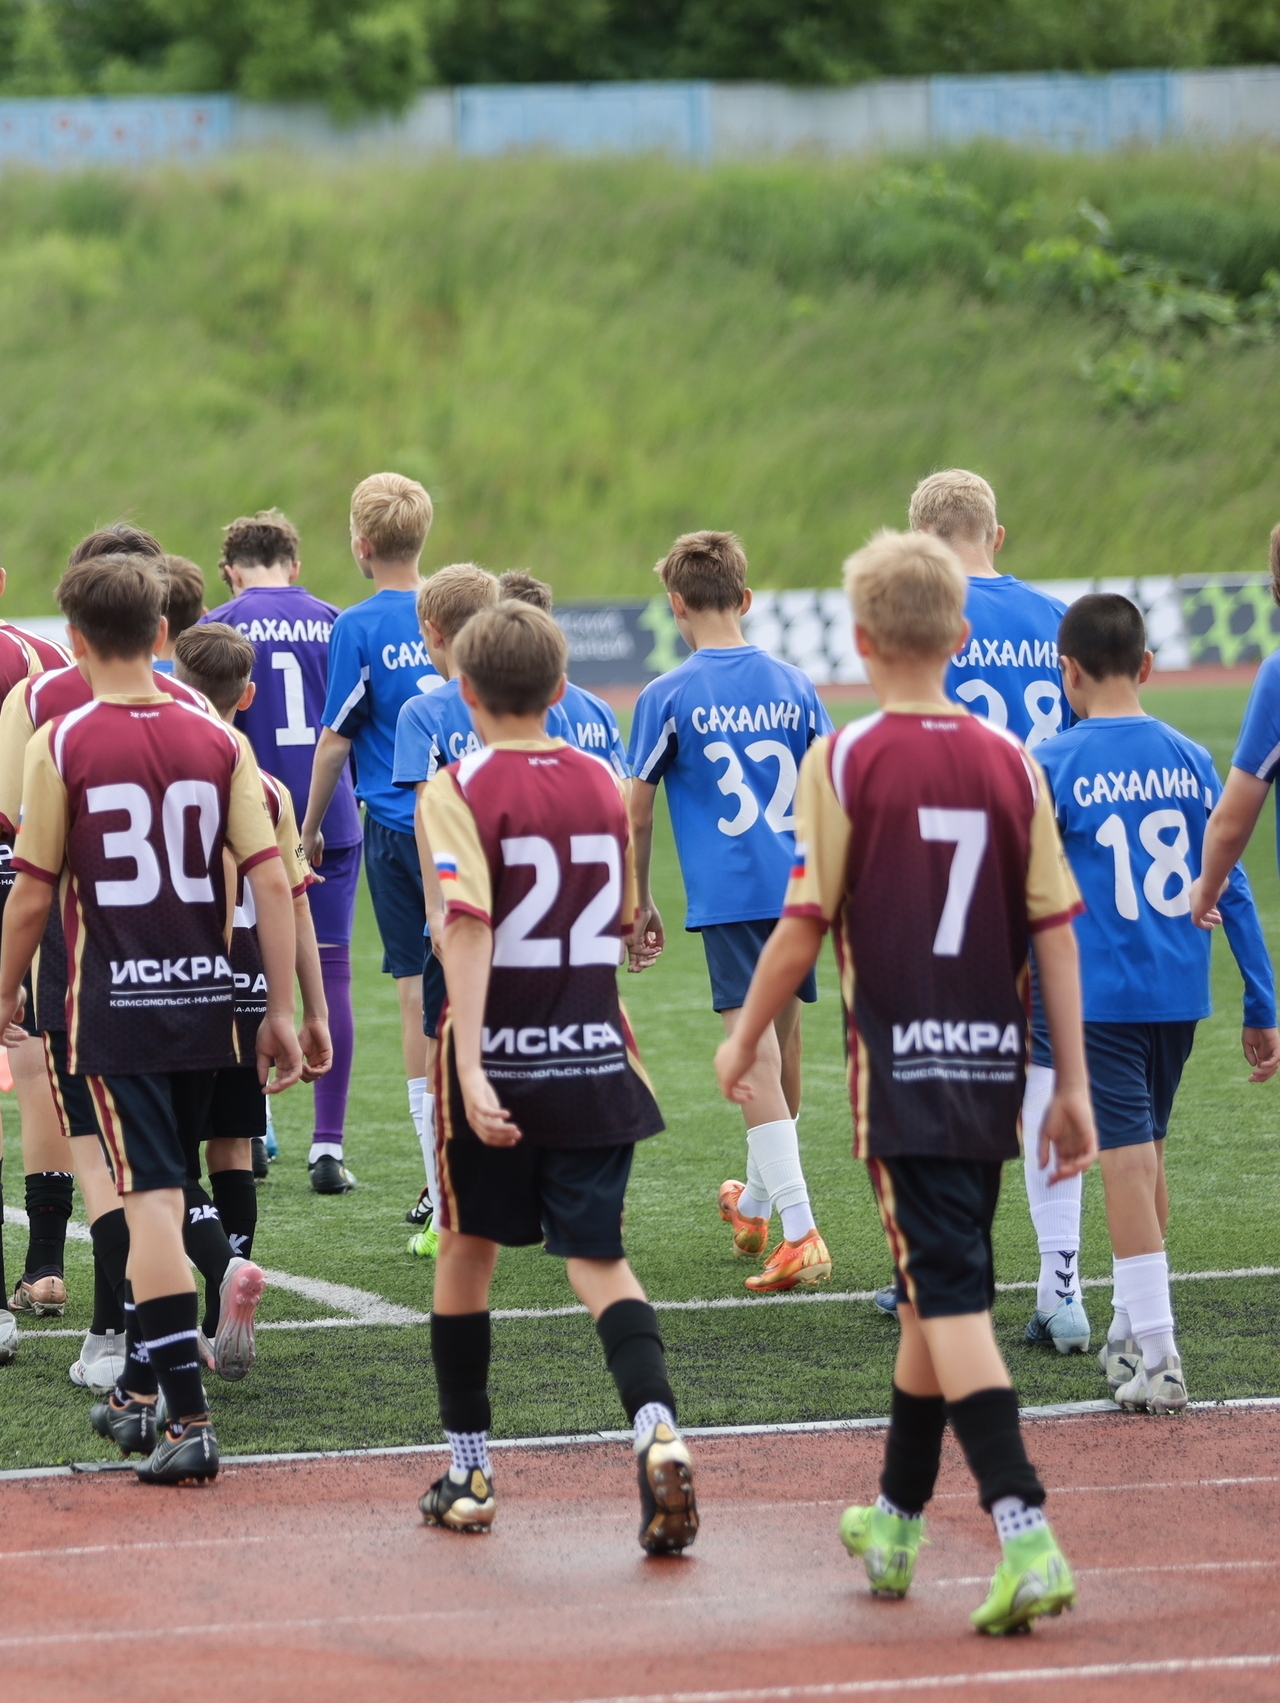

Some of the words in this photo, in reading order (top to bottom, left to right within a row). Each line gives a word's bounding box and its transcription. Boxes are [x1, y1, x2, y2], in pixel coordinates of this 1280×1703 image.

[271, 651, 316, 747] 1
[691, 701, 800, 734] САХАЛИН
[703, 739, 797, 837] 32
[1073, 767, 1199, 808] САХАЛИН
[86, 780, 220, 906] 30
[918, 807, 987, 956] 7
[1095, 809, 1192, 921] 18
[492, 834, 622, 968] 22
[109, 955, 233, 984] ИСКРА
[481, 1021, 623, 1055] ИСКРА
[891, 1018, 1020, 1055] ИСКРА
[188, 1204, 219, 1224] 2K
[228, 1233, 249, 1254] K
